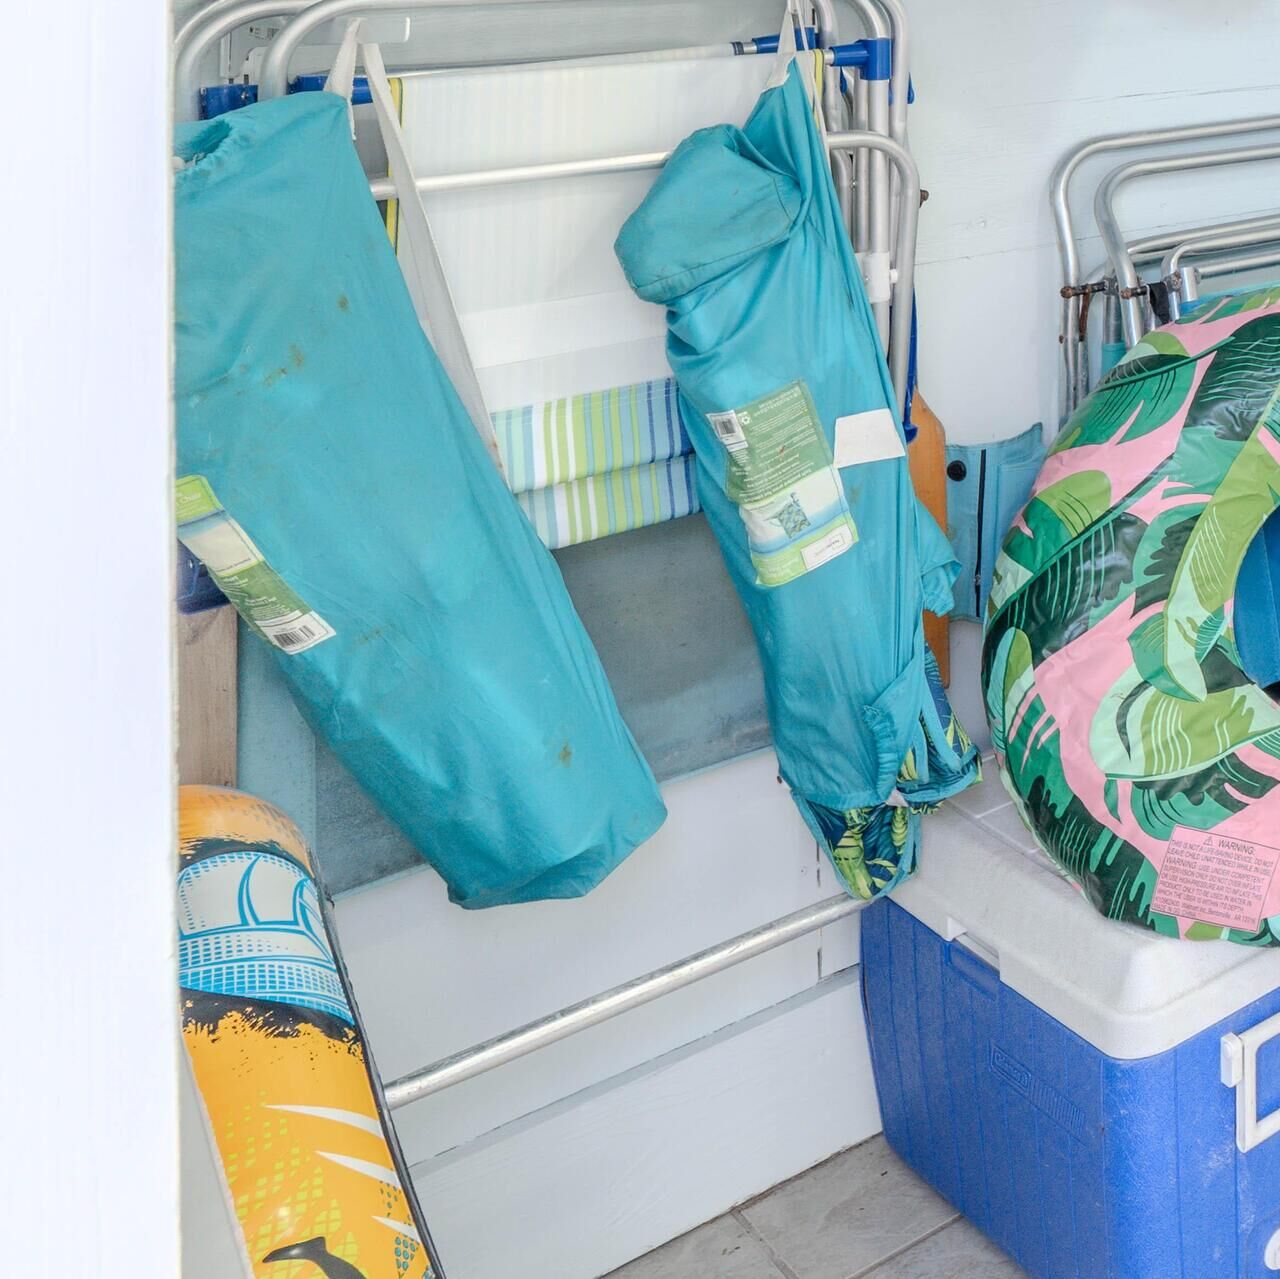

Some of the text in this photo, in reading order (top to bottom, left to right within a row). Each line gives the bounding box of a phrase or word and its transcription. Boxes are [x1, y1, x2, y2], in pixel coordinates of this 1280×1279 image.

[1188, 843, 1201, 852] NOT
[1263, 860, 1274, 869] NOT
[1218, 840, 1257, 856] WARNING:
[1168, 847, 1185, 857] LEAVE
[1185, 851, 1201, 860] CHILD
[1236, 863, 1254, 872] WHILE
[1199, 864, 1211, 872] USE
[1211, 866, 1231, 877] UNDER
